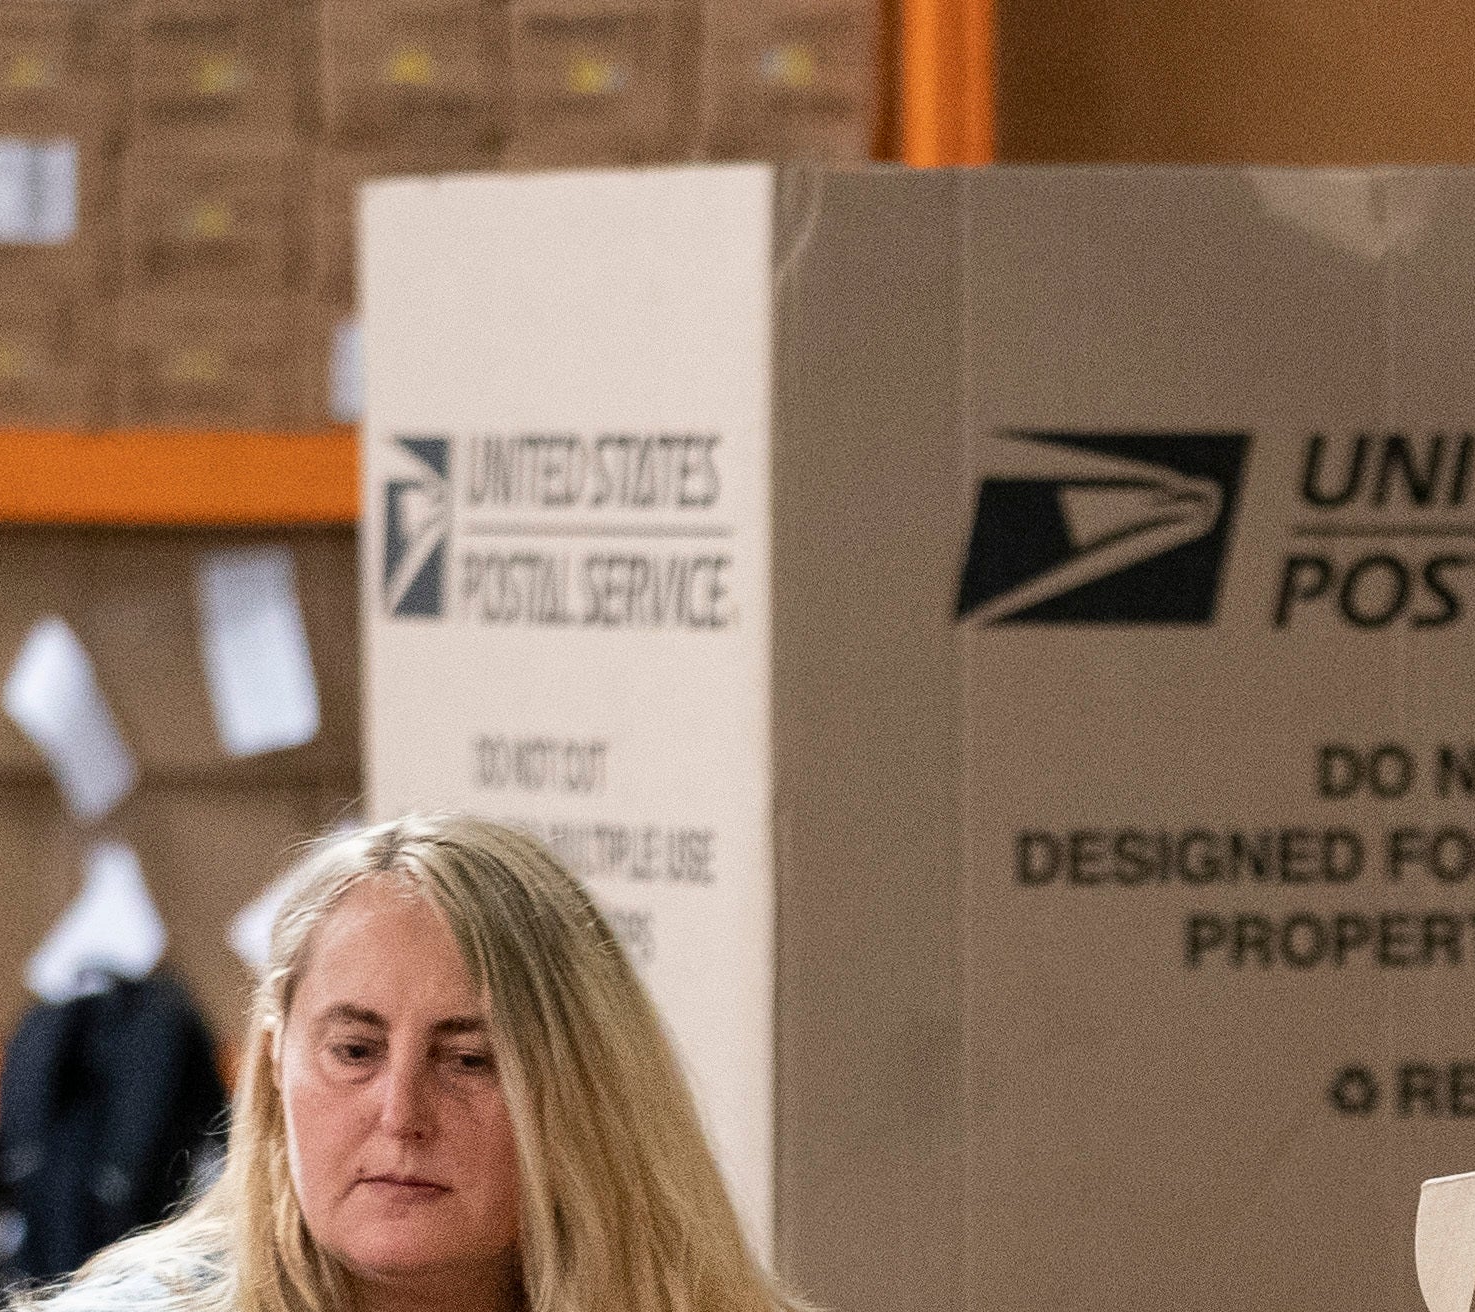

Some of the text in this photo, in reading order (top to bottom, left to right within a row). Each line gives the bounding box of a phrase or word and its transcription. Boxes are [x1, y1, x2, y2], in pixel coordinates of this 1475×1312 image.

[465, 433, 721, 510] UNITED STATES
[1316, 741, 1416, 800] DO
[1015, 825, 1365, 887] DESIGNED
